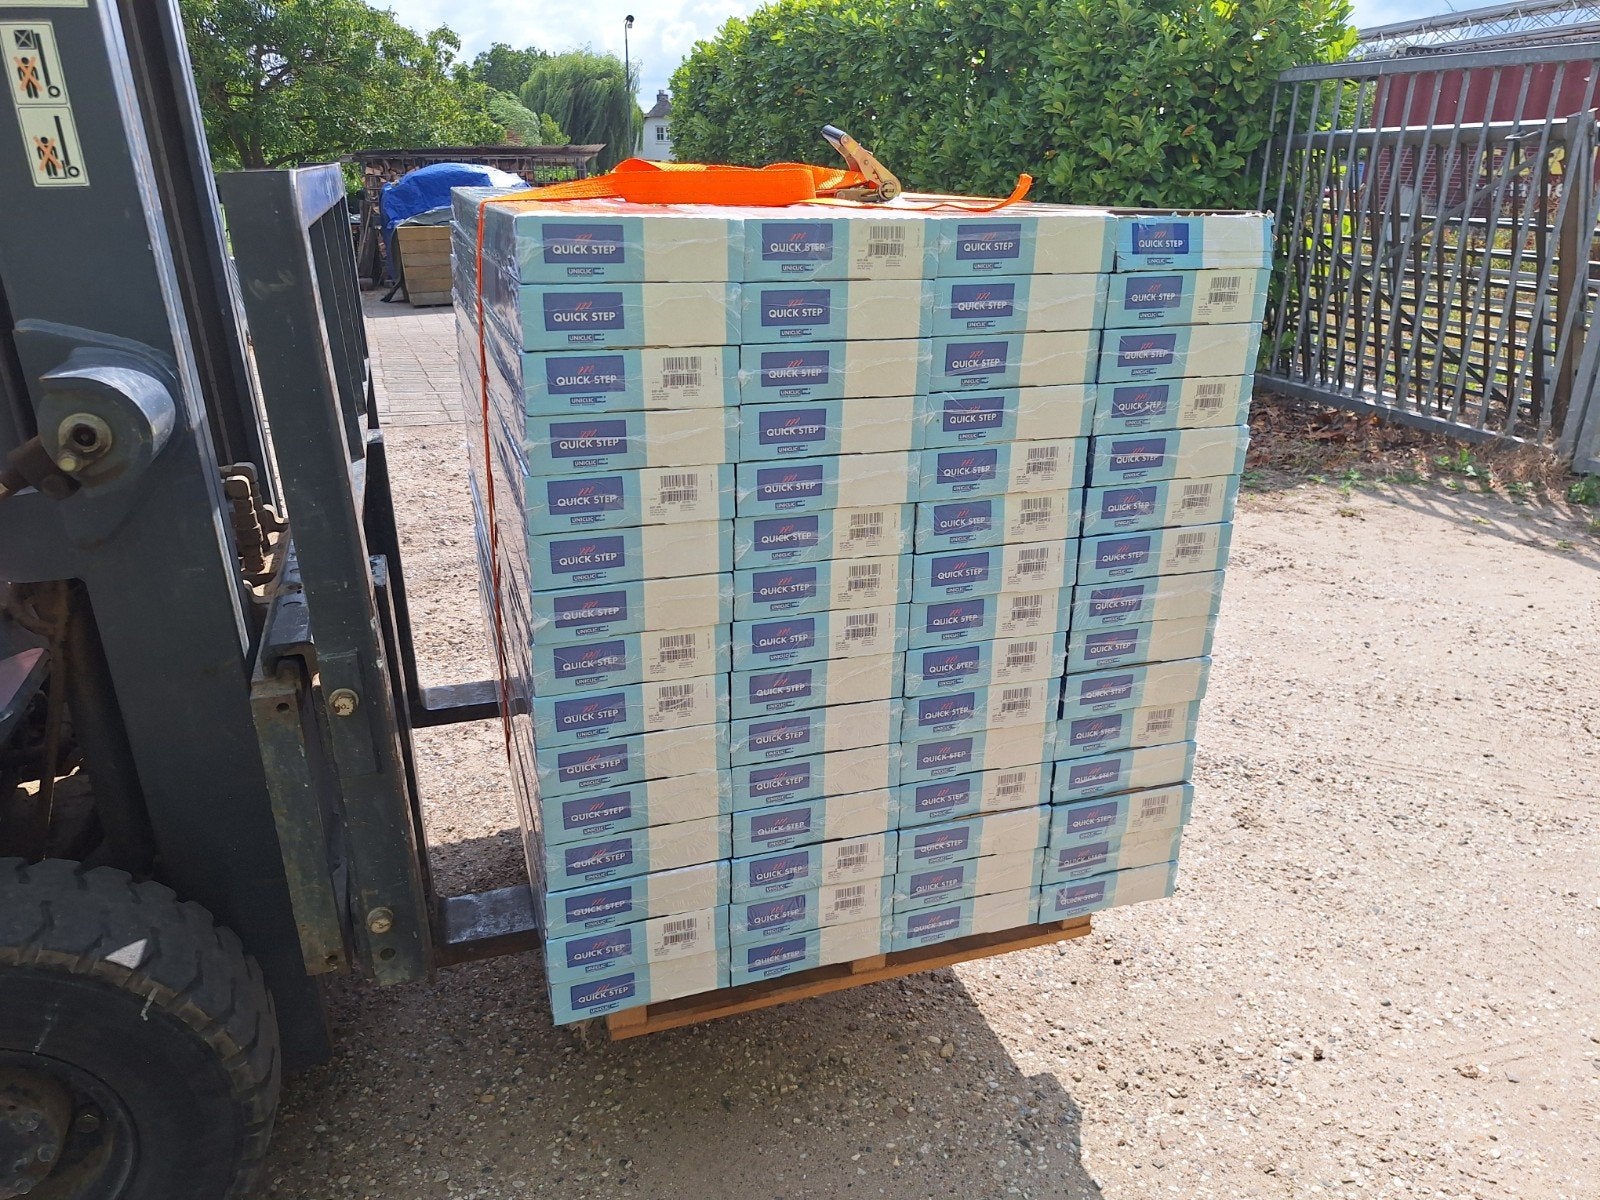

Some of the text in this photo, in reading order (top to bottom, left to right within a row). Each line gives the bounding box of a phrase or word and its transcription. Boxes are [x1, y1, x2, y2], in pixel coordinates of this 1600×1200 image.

[770, 243, 826, 252] QUICK STEP
[964, 242, 1013, 252] QUICK STEP
[1138, 240, 1163, 248] QUICK
[552, 245, 616, 255] QUICK STEP
[568, 267, 592, 275] UNICLIC
[1131, 292, 1176, 302] QUICK STEP
[958, 301, 1007, 311] QUICK STEP
[553, 312, 616, 322] QUICK STEP
[769, 308, 823, 318] QUICK STEP
[1124, 349, 1168, 359] QUICK STEP
[952, 358, 1000, 368] QUICK STEP
[768, 368, 822, 378] QUICK STEP
[556, 375, 617, 386] QUICK STEP
[1118, 400, 1162, 411] QUICK STEP
[950, 413, 997, 424] QUICK STEP
[766, 425, 819, 436] QUICK STEP
[559, 437, 619, 449] QUICK STEP
[1116, 453, 1159, 464] QUICK STEP
[944, 465, 990, 476] QUICK STEP
[764, 481, 816, 493] QUICK STEP
[557, 494, 616, 507] QUICK STEP
[1108, 503, 1131, 512] QUICK
[940, 516, 986, 528] QUICK STEP
[761, 531, 812, 543] QUICK STEP
[559, 552, 617, 565] QUICK STEP
[1102, 551, 1144, 562] QUICK STEP
[938, 567, 983, 579] QUICK STEP
[760, 583, 810, 595] QUICK STEP
[1120, 598, 1137, 607] STEP
[563, 606, 619, 620] QUICK STEP
[933, 614, 978, 625] QUICK STEP
[759, 633, 808, 646] QUICK STEP
[1090, 642, 1131, 653] QUICK STEP
[563, 656, 618, 670] QUICK STEP
[929, 661, 973, 673] QUICK STEP
[756, 684, 805, 696] QUICK STEP
[564, 709, 619, 723] QUICK STEP
[925, 706, 969, 719] QUICK STEP
[756, 731, 804, 744] QUICK STEP
[1076, 730, 1098, 739] QUICK
[923, 754, 947, 763] QUICK
[566, 759, 621, 773] QUICK STEP
[756, 776, 804, 790] QUICK STEP
[922, 792, 964, 805] QUICK STEP
[571, 806, 624, 821] QUICK STEP
[758, 821, 804, 835] QUICK STEP
[1073, 818, 1094, 827] QUICK
[920, 839, 963, 852] QUICK STEP
[573, 853, 626, 868] QUICK STEP
[756, 865, 803, 879] QUICK STEP
[916, 879, 957, 892] QUICK STEP
[573, 900, 625, 915] QUICK STEP
[754, 913, 779, 923] QUICK
[913, 922, 936, 932] QUICK
[574, 943, 625, 960] QUICK STEP
[754, 955, 780, 965] QUICK
[578, 986, 628, 1002] QUICK STEP
